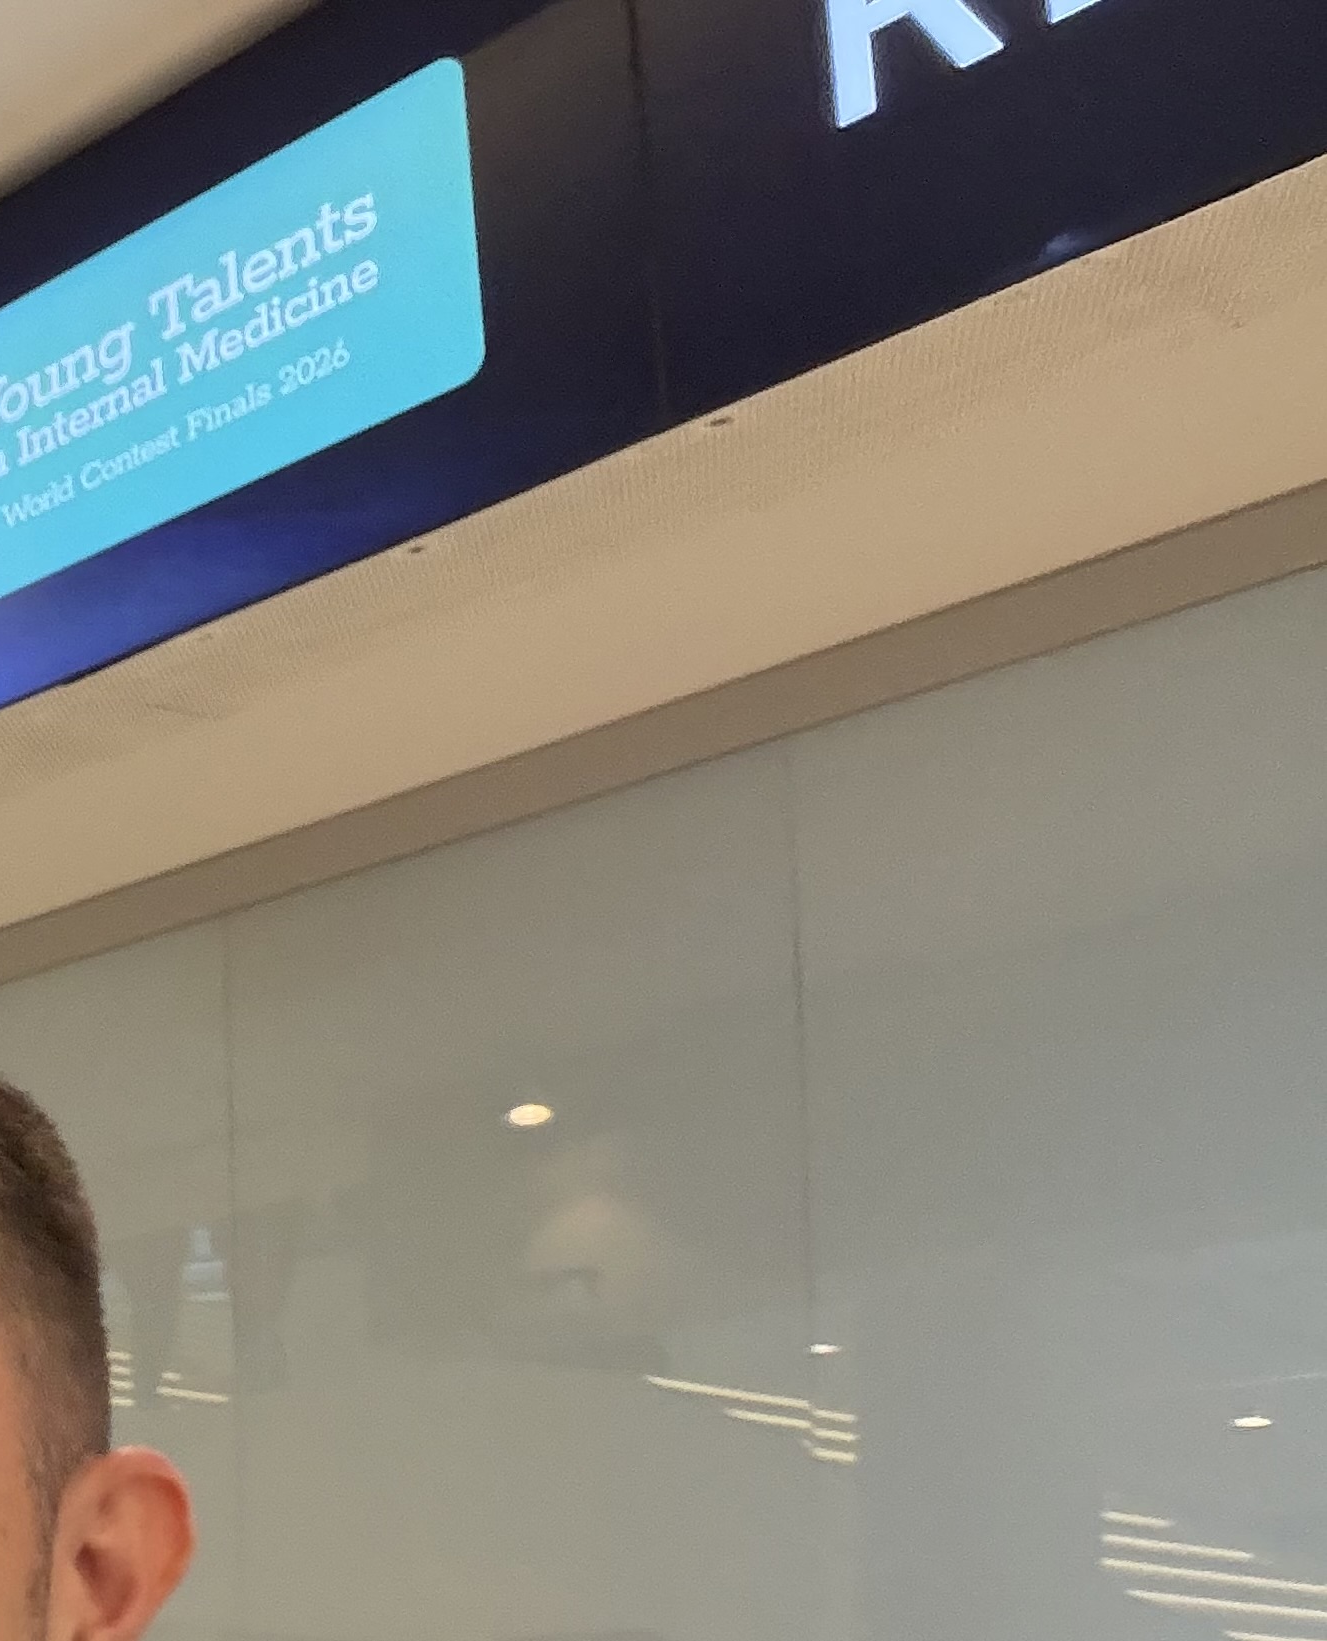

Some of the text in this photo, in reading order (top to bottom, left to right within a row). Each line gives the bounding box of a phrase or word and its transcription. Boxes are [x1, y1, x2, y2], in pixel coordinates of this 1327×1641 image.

[147, 193, 378, 340] Talents
[0, 338, 351, 527] World Contest Finals 2026
[16, 360, 167, 466] Internal
[177, 258, 380, 382] Medicine
